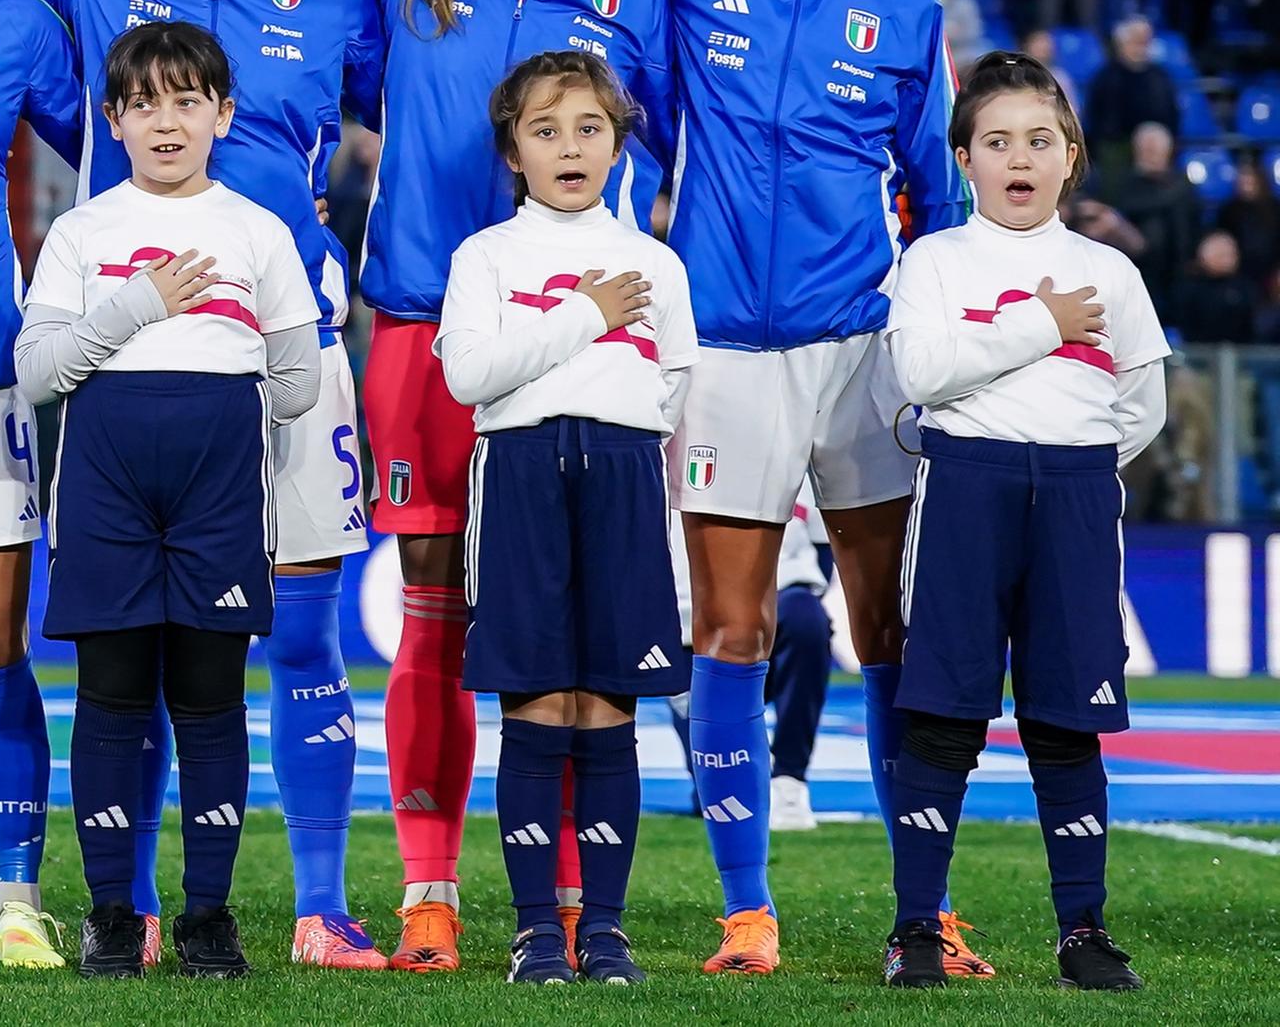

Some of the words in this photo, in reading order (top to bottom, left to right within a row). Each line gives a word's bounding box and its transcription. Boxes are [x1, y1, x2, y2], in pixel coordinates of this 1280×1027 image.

[145, 2, 171, 18] TIM
[851, 13, 877, 25] ITALIA
[269, 25, 303, 38] Telepass
[580, 18, 613, 38] Telepass
[568, 35, 592, 51] eni
[725, 34, 750, 50] TIM
[261, 45, 285, 59] eni
[707, 48, 744, 66] Poste
[839, 62, 875, 79] Telepass
[826, 81, 850, 98] eni
[4, 411, 36, 483] 4
[690, 449, 714, 459] ITALIA
[331, 424, 360, 501] 5
[292, 676, 349, 701] ITALIA
[692, 749, 750, 768] ITALIA
